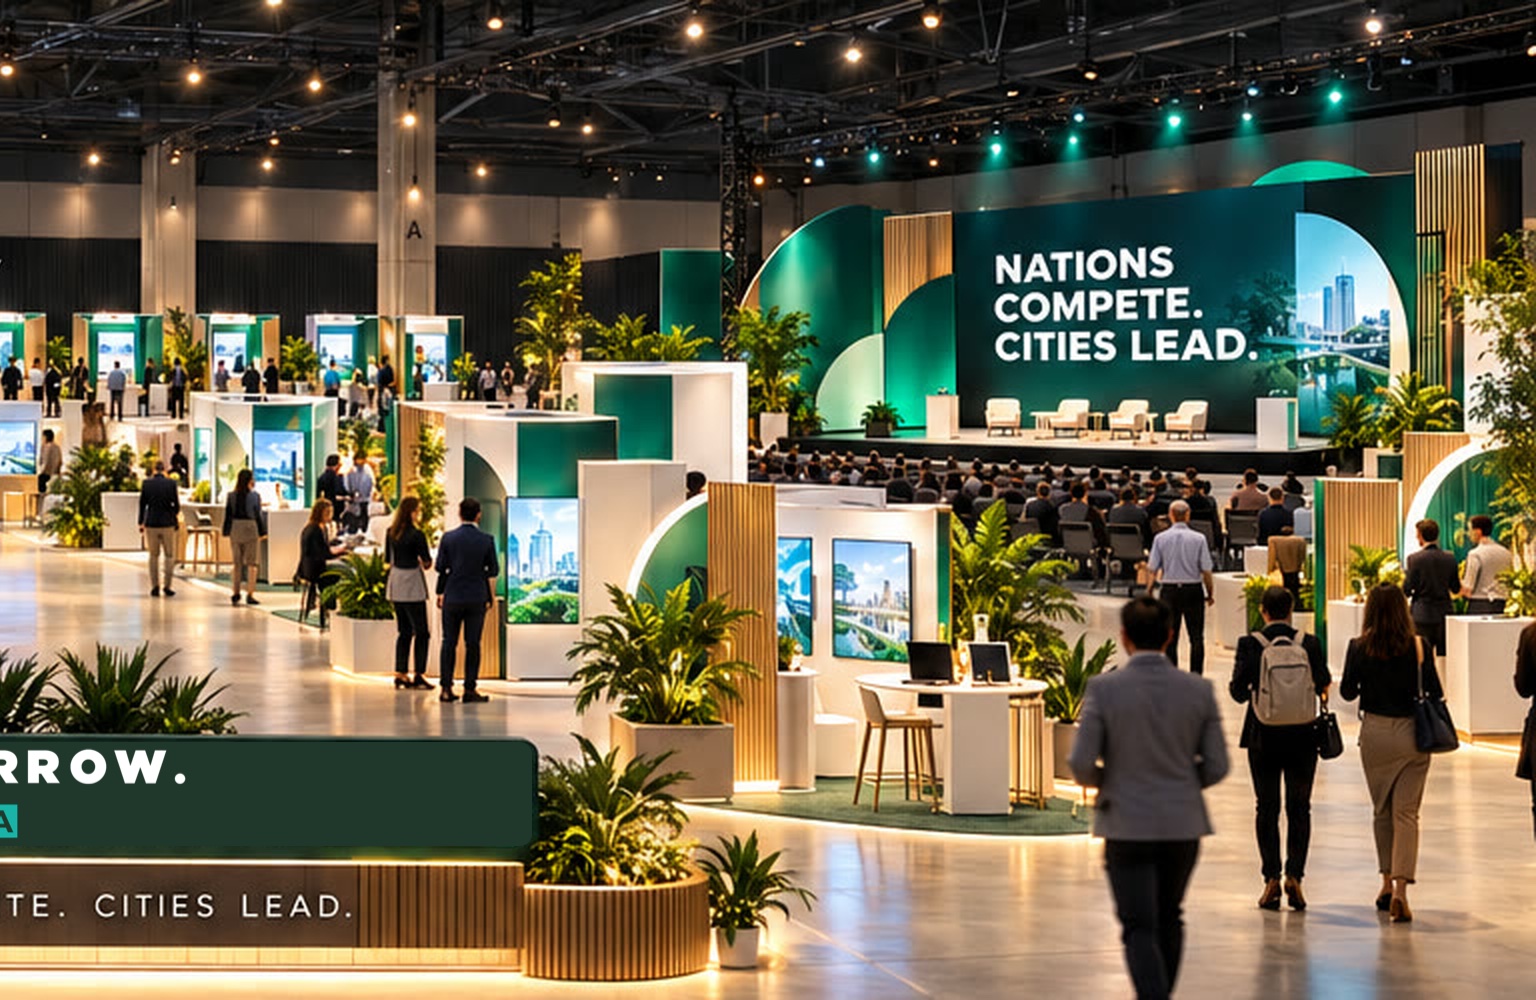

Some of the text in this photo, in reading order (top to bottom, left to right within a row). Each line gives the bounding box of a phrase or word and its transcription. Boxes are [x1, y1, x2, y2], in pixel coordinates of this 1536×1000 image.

[407, 220, 422, 239] A
[995, 245, 1175, 285] NATIONS
[994, 286, 1204, 324] COMPETE.
[994, 327, 1259, 363] CITIES LEAD.
[94, 892, 215, 918] CITIES
[242, 893, 353, 919] LEAD.
